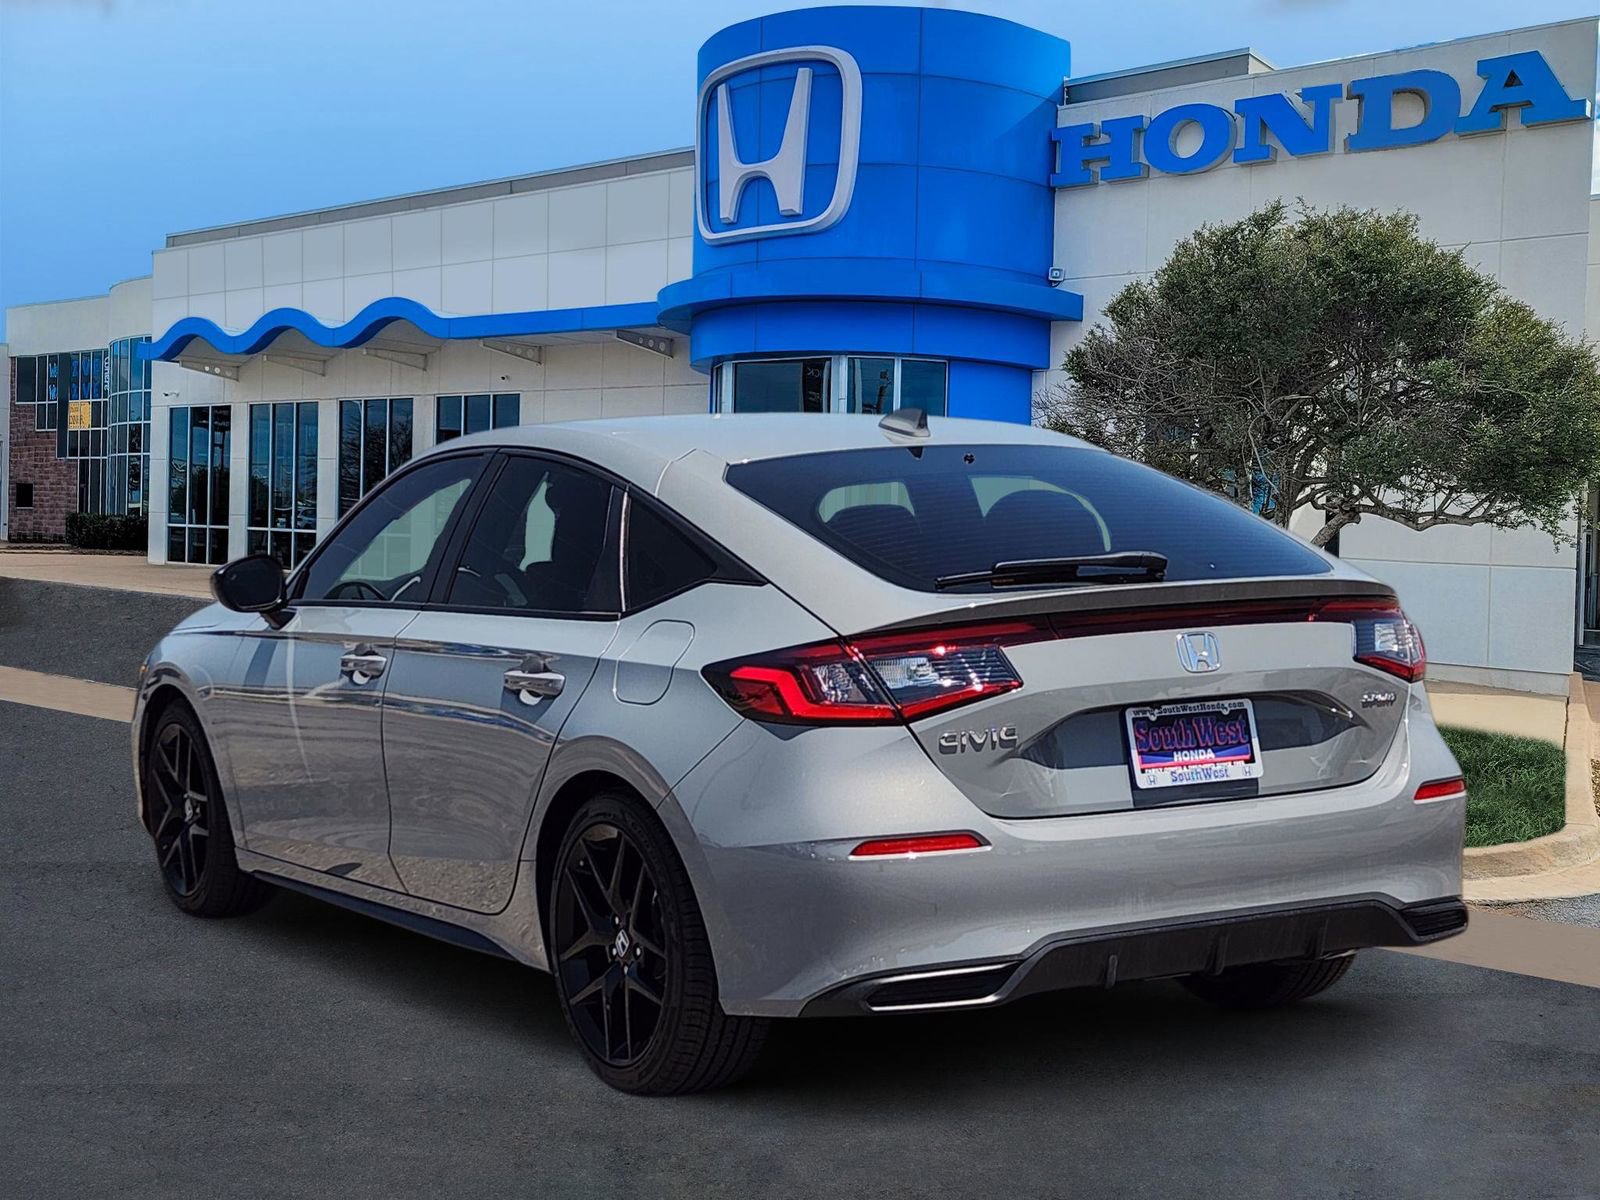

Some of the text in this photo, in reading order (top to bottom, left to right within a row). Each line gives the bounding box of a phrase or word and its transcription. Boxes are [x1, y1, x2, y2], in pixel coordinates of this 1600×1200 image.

[1051, 50, 1591, 188] HONDA
[939, 725, 1017, 754] CIVIC
[1135, 714, 1249, 752] SouthWest
[1173, 748, 1216, 762] HONDA
[1170, 767, 1229, 783] SouthWest
